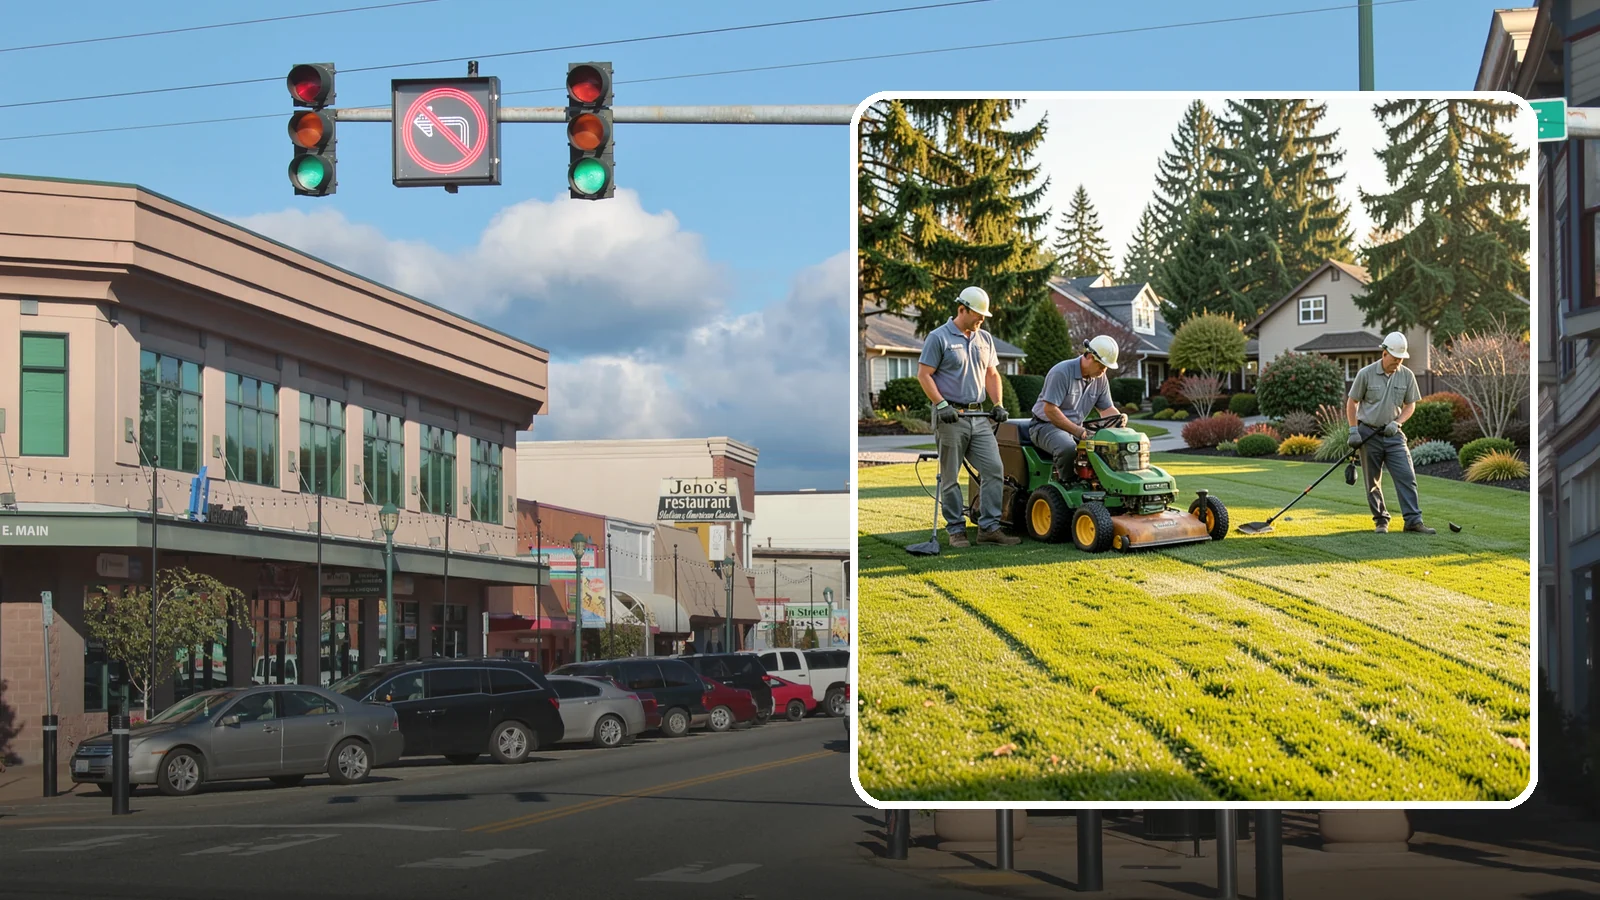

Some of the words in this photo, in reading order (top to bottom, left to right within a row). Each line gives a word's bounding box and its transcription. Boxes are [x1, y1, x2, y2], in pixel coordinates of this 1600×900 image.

[669, 480, 727, 494] Jeno's
[665, 496, 731, 509] restaurant
[686, 509, 714, 520] American
[715, 509, 738, 519] Cuisine
[2, 525, 13, 536] E.
[15, 525, 49, 536] MAIN
[797, 607, 828, 617] Street
